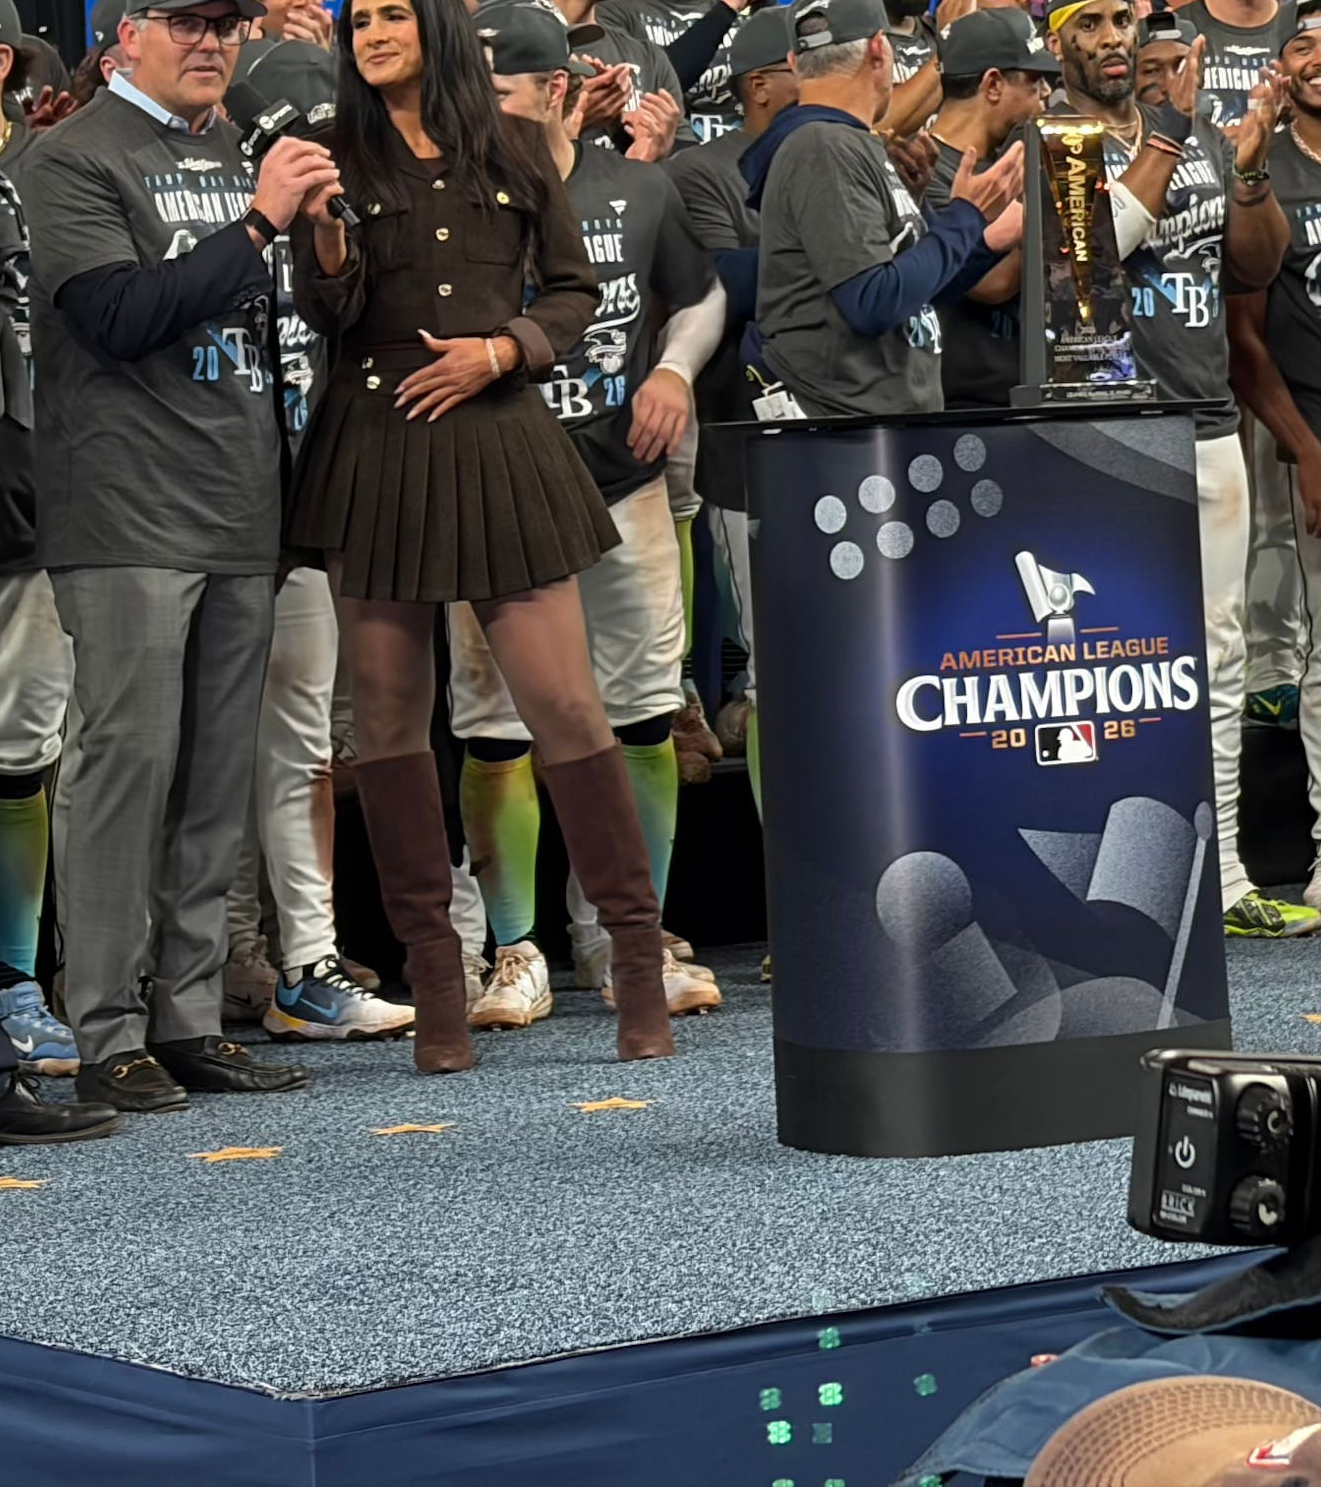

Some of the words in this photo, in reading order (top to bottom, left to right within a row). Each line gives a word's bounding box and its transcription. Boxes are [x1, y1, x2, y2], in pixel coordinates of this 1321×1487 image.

[1065, 156, 1088, 262] AMERICAN
[1132, 287, 1155, 317] 20
[1161, 273, 1209, 328] TB
[192, 346, 220, 382] 20
[222, 327, 264, 393] TB
[603, 376, 626, 407] 26
[940, 642, 1076, 671] AMERICAN
[1083, 636, 1169, 660] LEAGUE
[896, 655, 1200, 732] CHAMPIONS
[991, 728, 1027, 750] 20
[1104, 719, 1136, 741] 26
